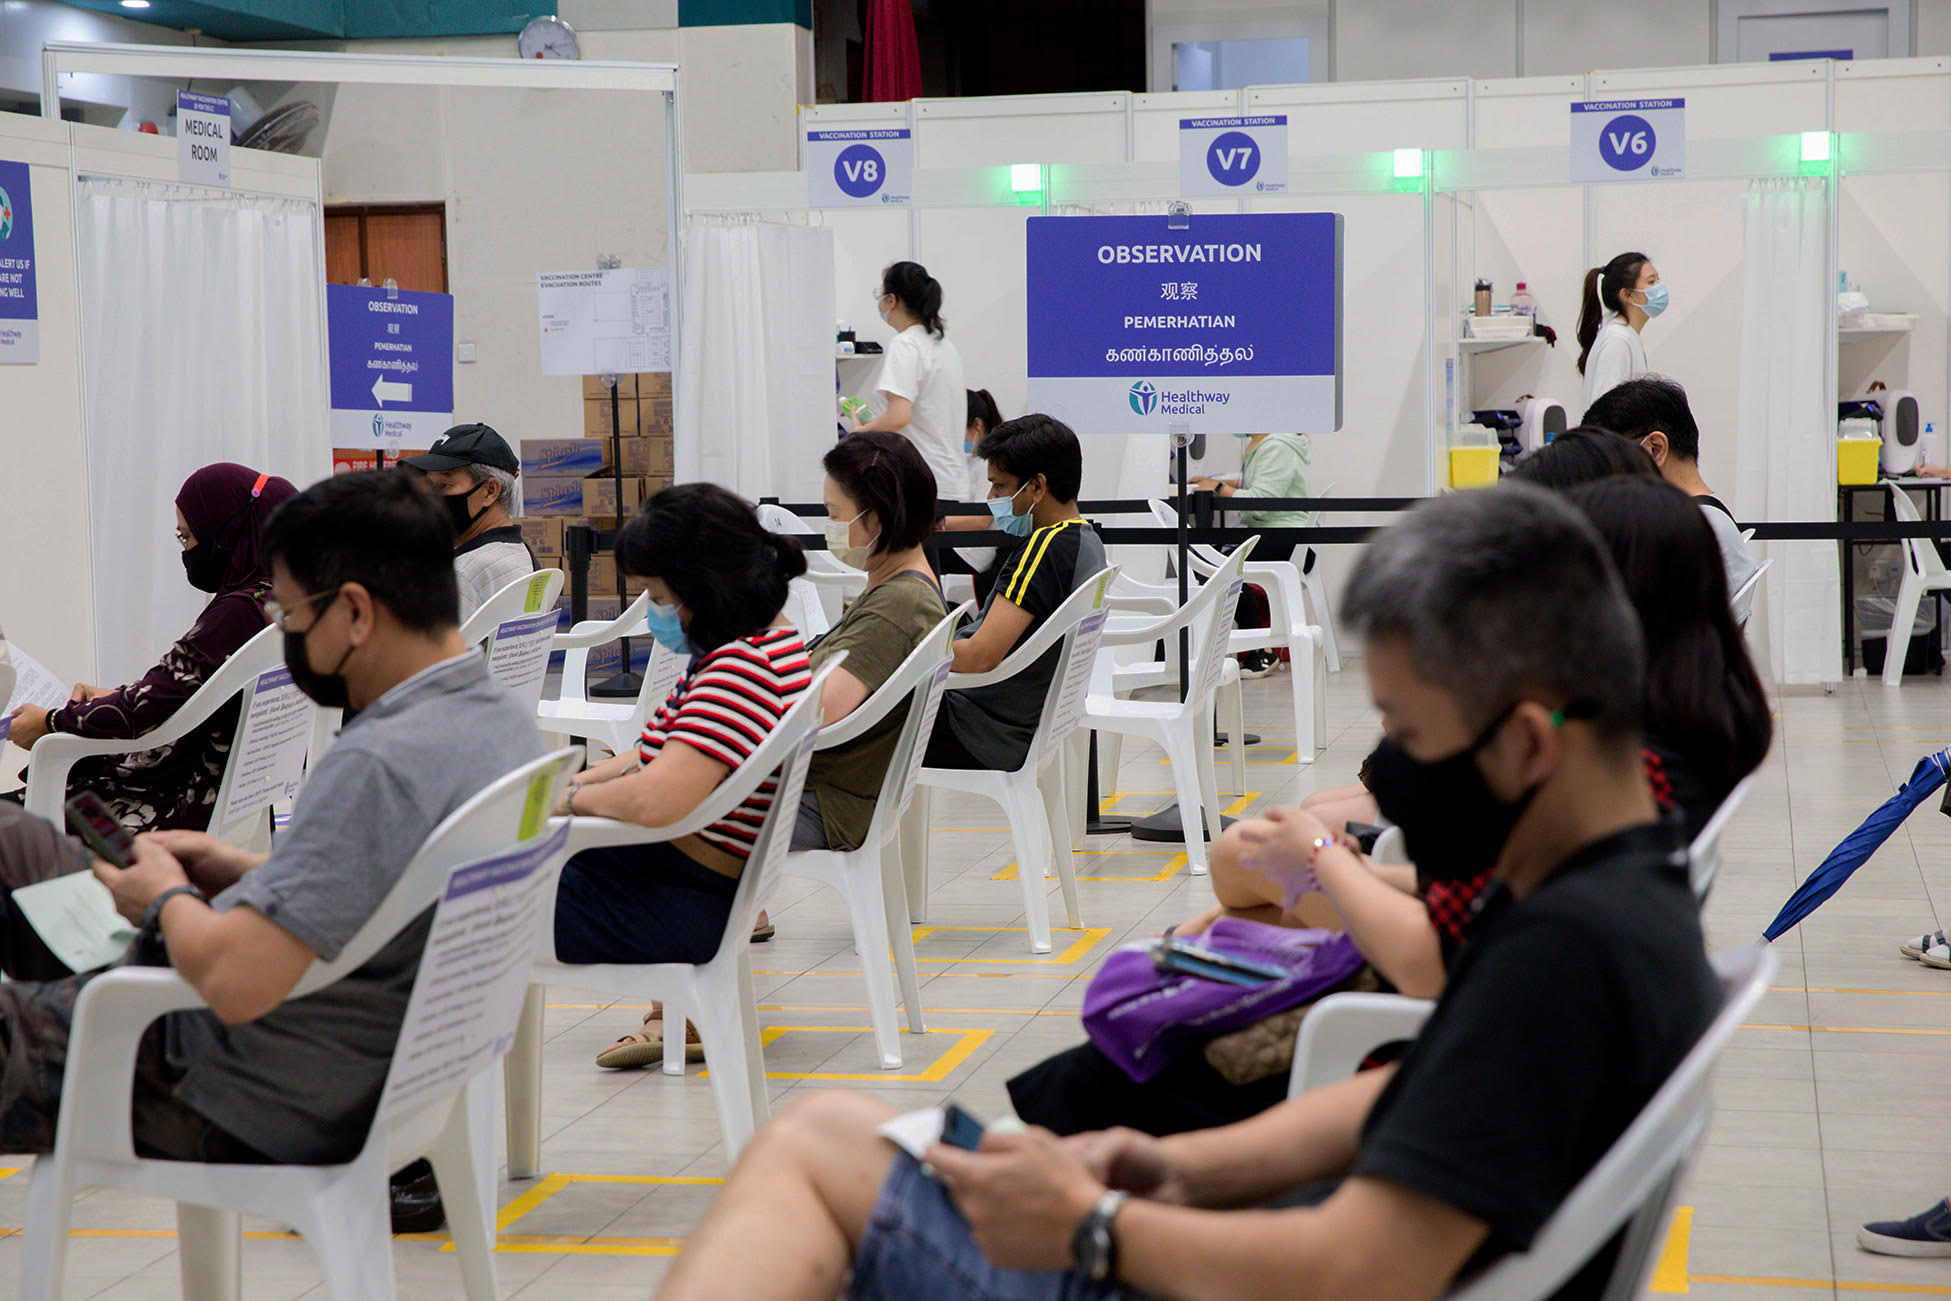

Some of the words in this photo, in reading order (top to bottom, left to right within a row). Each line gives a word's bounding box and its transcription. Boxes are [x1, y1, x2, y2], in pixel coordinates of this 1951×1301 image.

[1583, 102, 1636, 111] VACCINATION
[1639, 100, 1673, 108] STATION
[185, 119, 223, 139] MEDICAL
[1191, 119, 1241, 127] VACCINATION
[1244, 117, 1275, 125] STATION
[869, 130, 900, 138] STATION
[1608, 131, 1648, 155] V6
[191, 144, 218, 162] ROOM
[1215, 147, 1253, 171] V7
[842, 160, 878, 182] V8
[1097, 243, 1262, 264] OBSERVATION
[16, 259, 24, 269] US
[10, 274, 22, 283] NOT
[581, 272, 603, 280] CENTRE
[9, 287, 24, 298] WELL
[1160, 281, 1199, 301] 观察
[368, 301, 418, 315] OBSERVATION
[1124, 315, 1235, 329] PEMERHATIAN
[374, 342, 412, 352] PEMERHATIAN
[1105, 343, 1254, 367] கண்காணித்தல்
[1161, 390, 1230, 405] Healthway
[1161, 404, 1205, 415] Medical
[385, 421, 412, 430] Healthway
